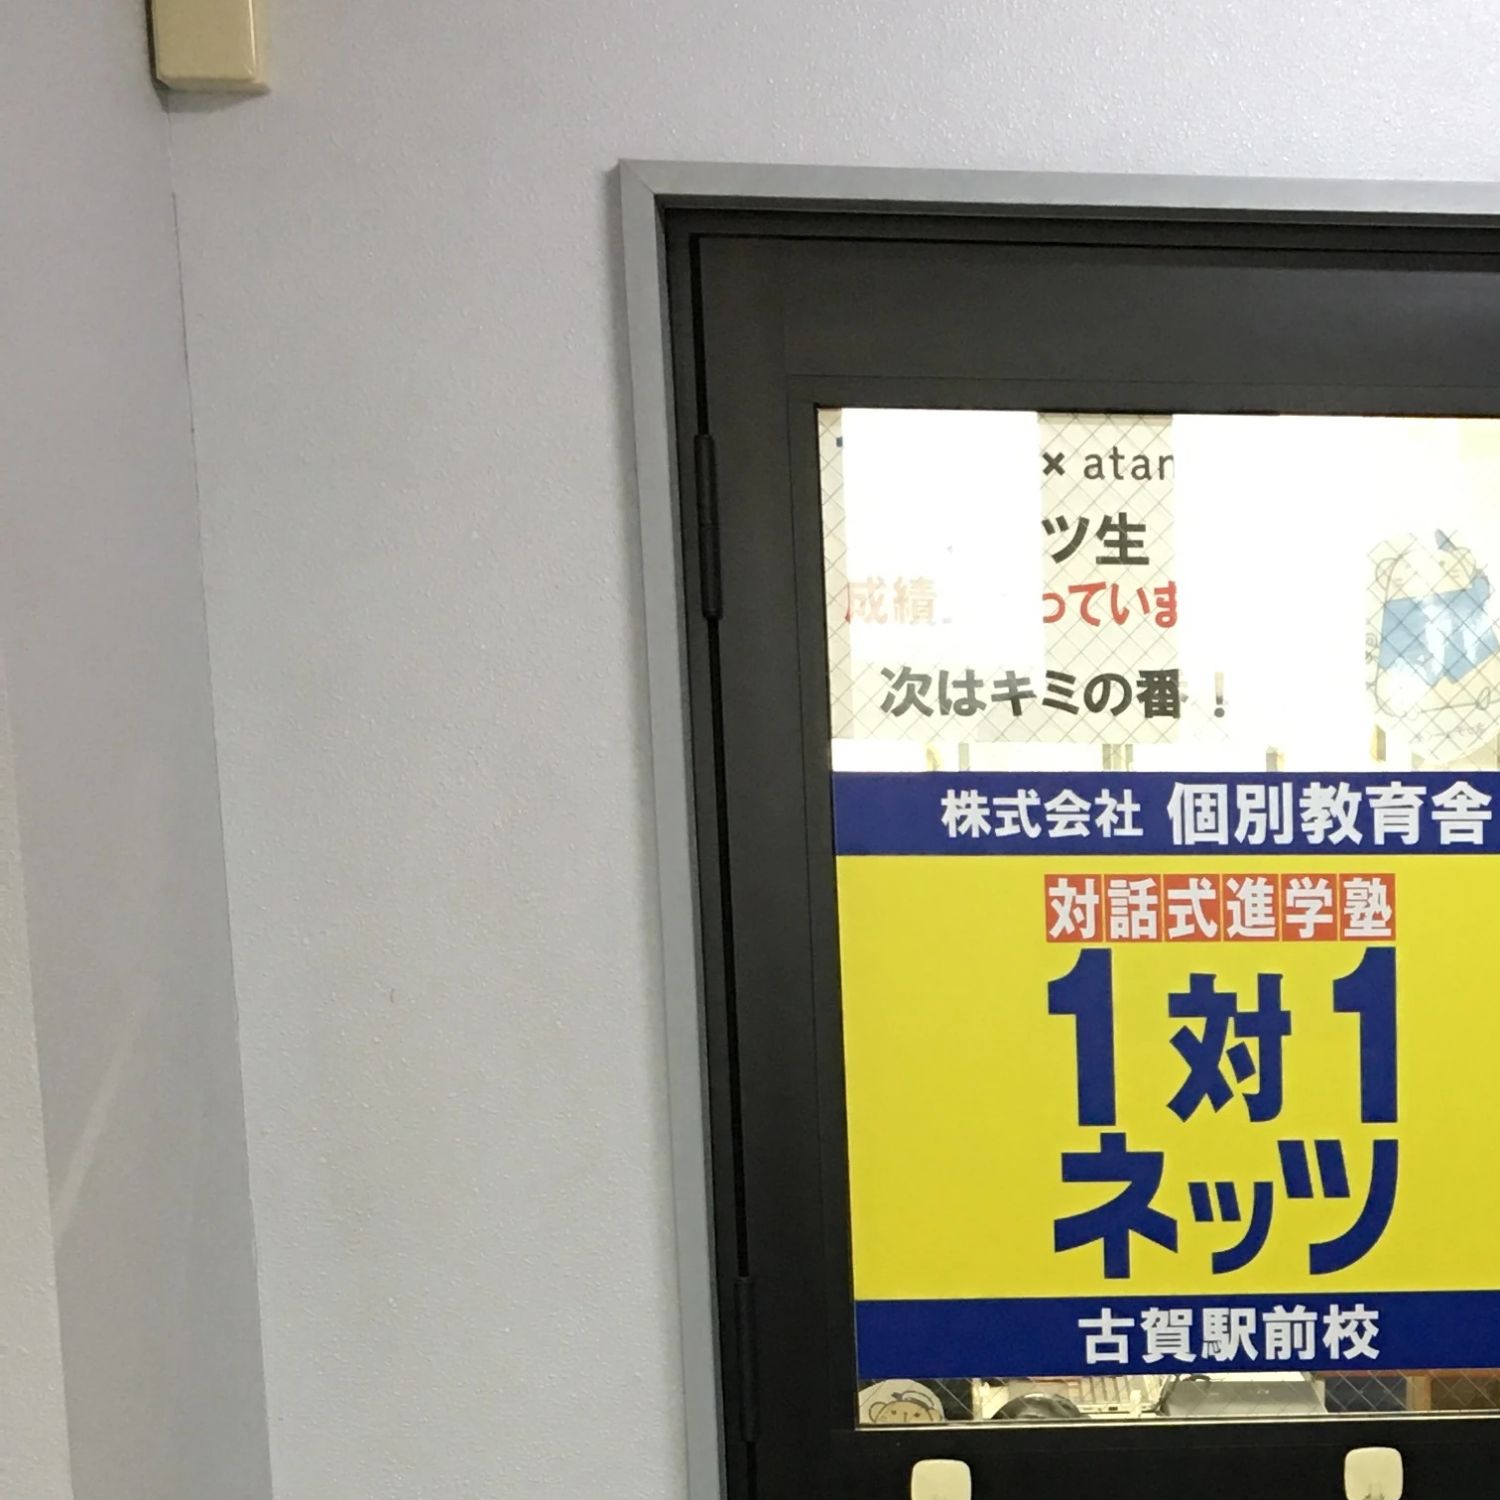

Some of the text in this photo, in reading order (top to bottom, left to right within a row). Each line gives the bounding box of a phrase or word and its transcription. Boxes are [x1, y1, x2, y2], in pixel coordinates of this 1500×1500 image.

[940, 781, 1493, 846] 株式会社 個別教育舎
[1050, 878, 1392, 938] 対話式進学塾
[1046, 946, 1399, 1127] 1対1
[1053, 1132, 1400, 1279] ネッツ
[1077, 1304, 1380, 1364] 古賀駅前校
